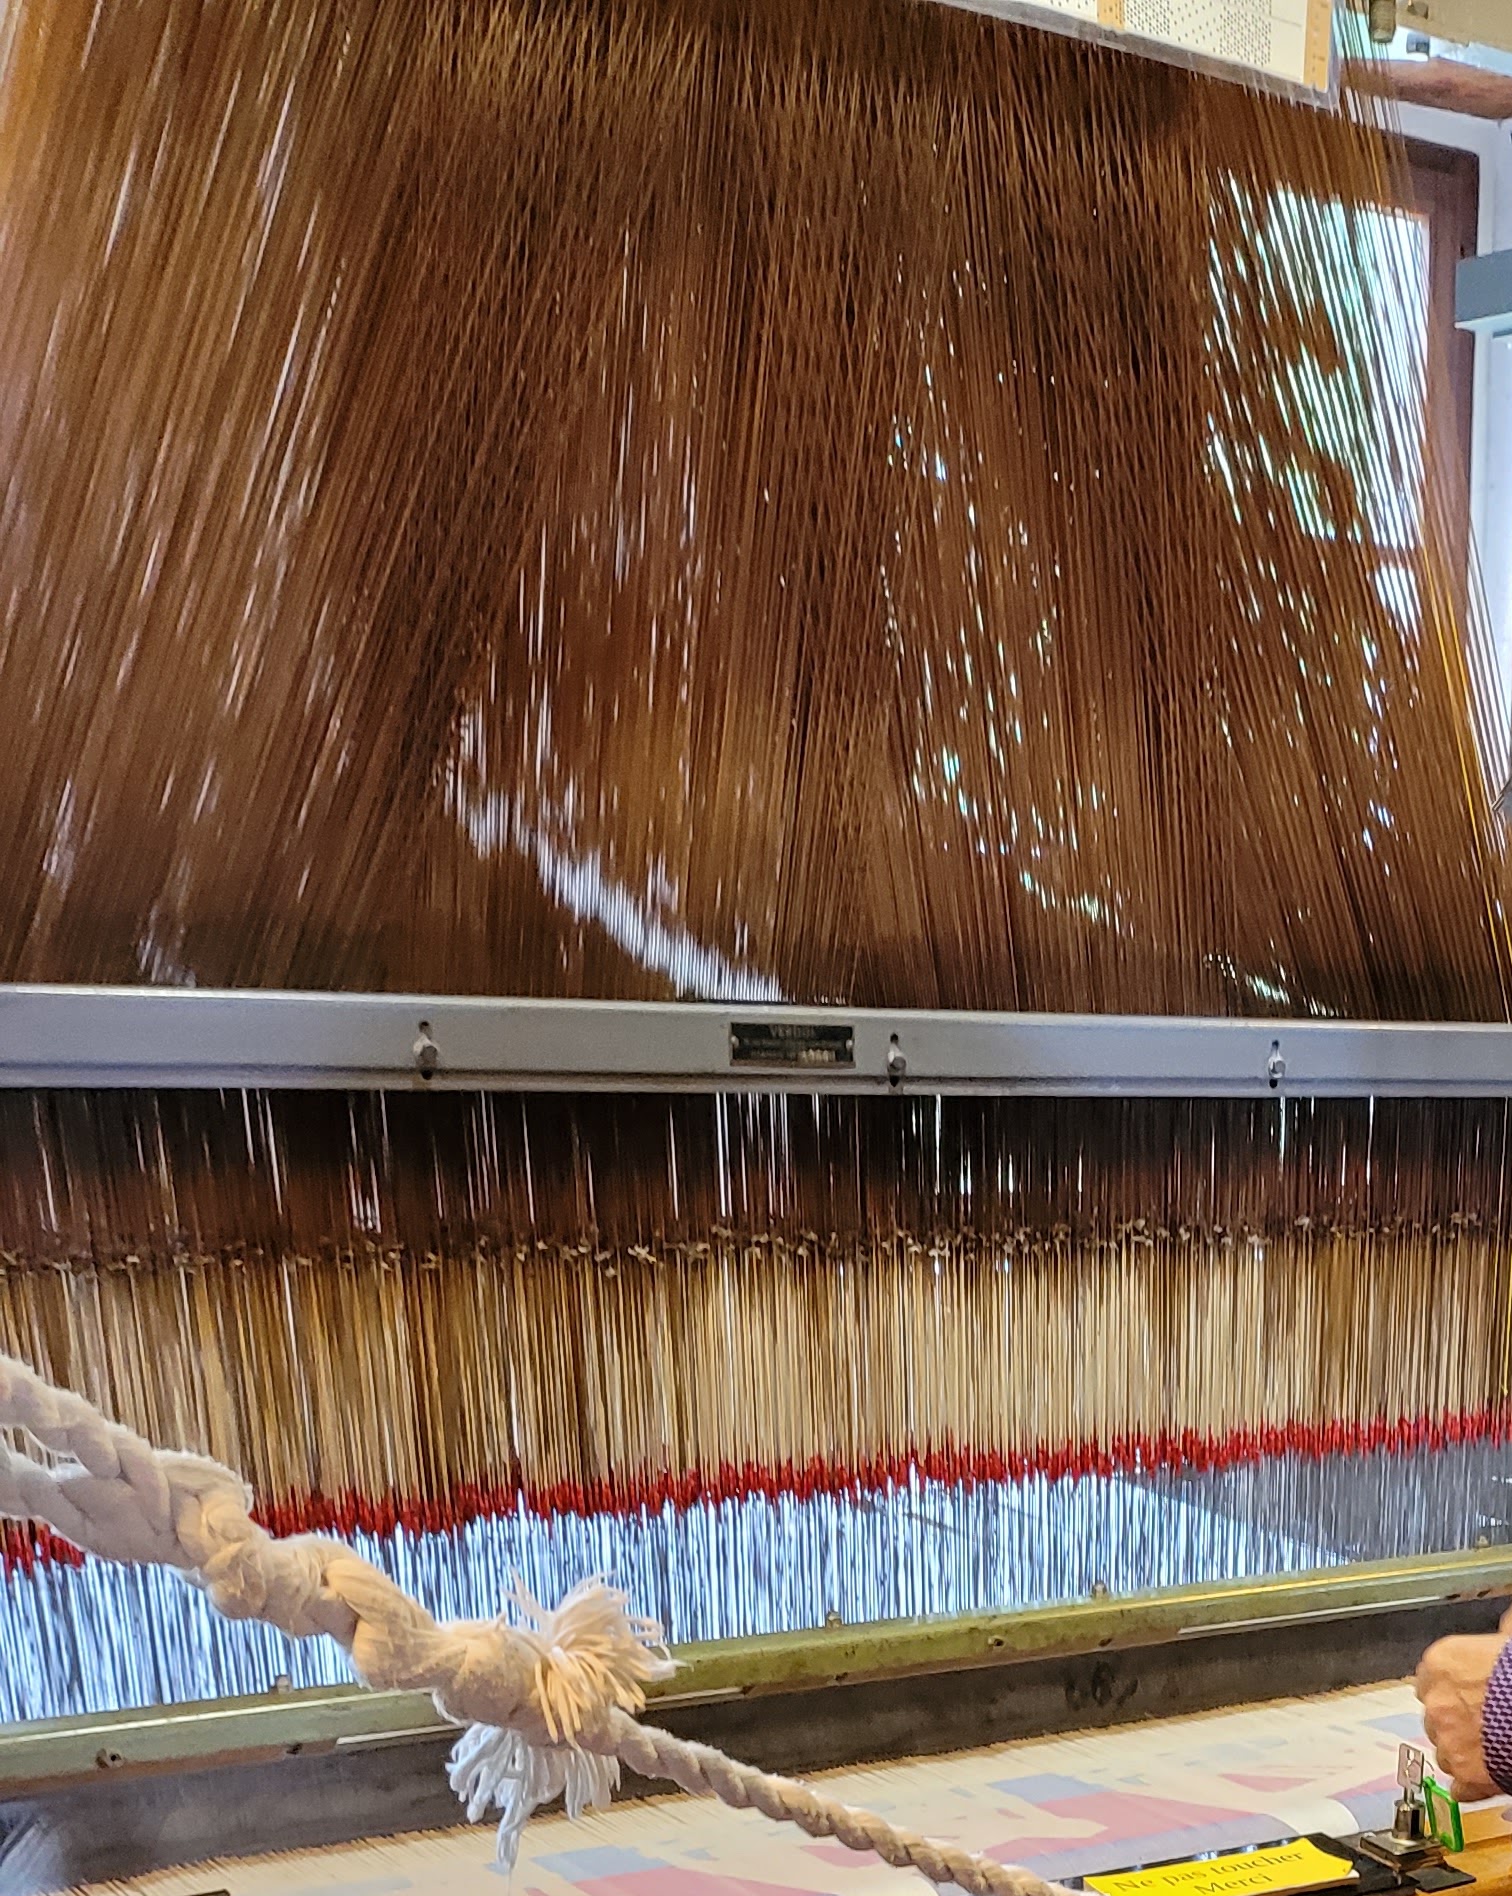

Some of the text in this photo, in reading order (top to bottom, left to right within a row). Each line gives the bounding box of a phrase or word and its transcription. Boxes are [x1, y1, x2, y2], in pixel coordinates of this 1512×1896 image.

[1112, 1850, 1305, 1893] Ne pas toucher
[1193, 1872, 1274, 1896] Merci
